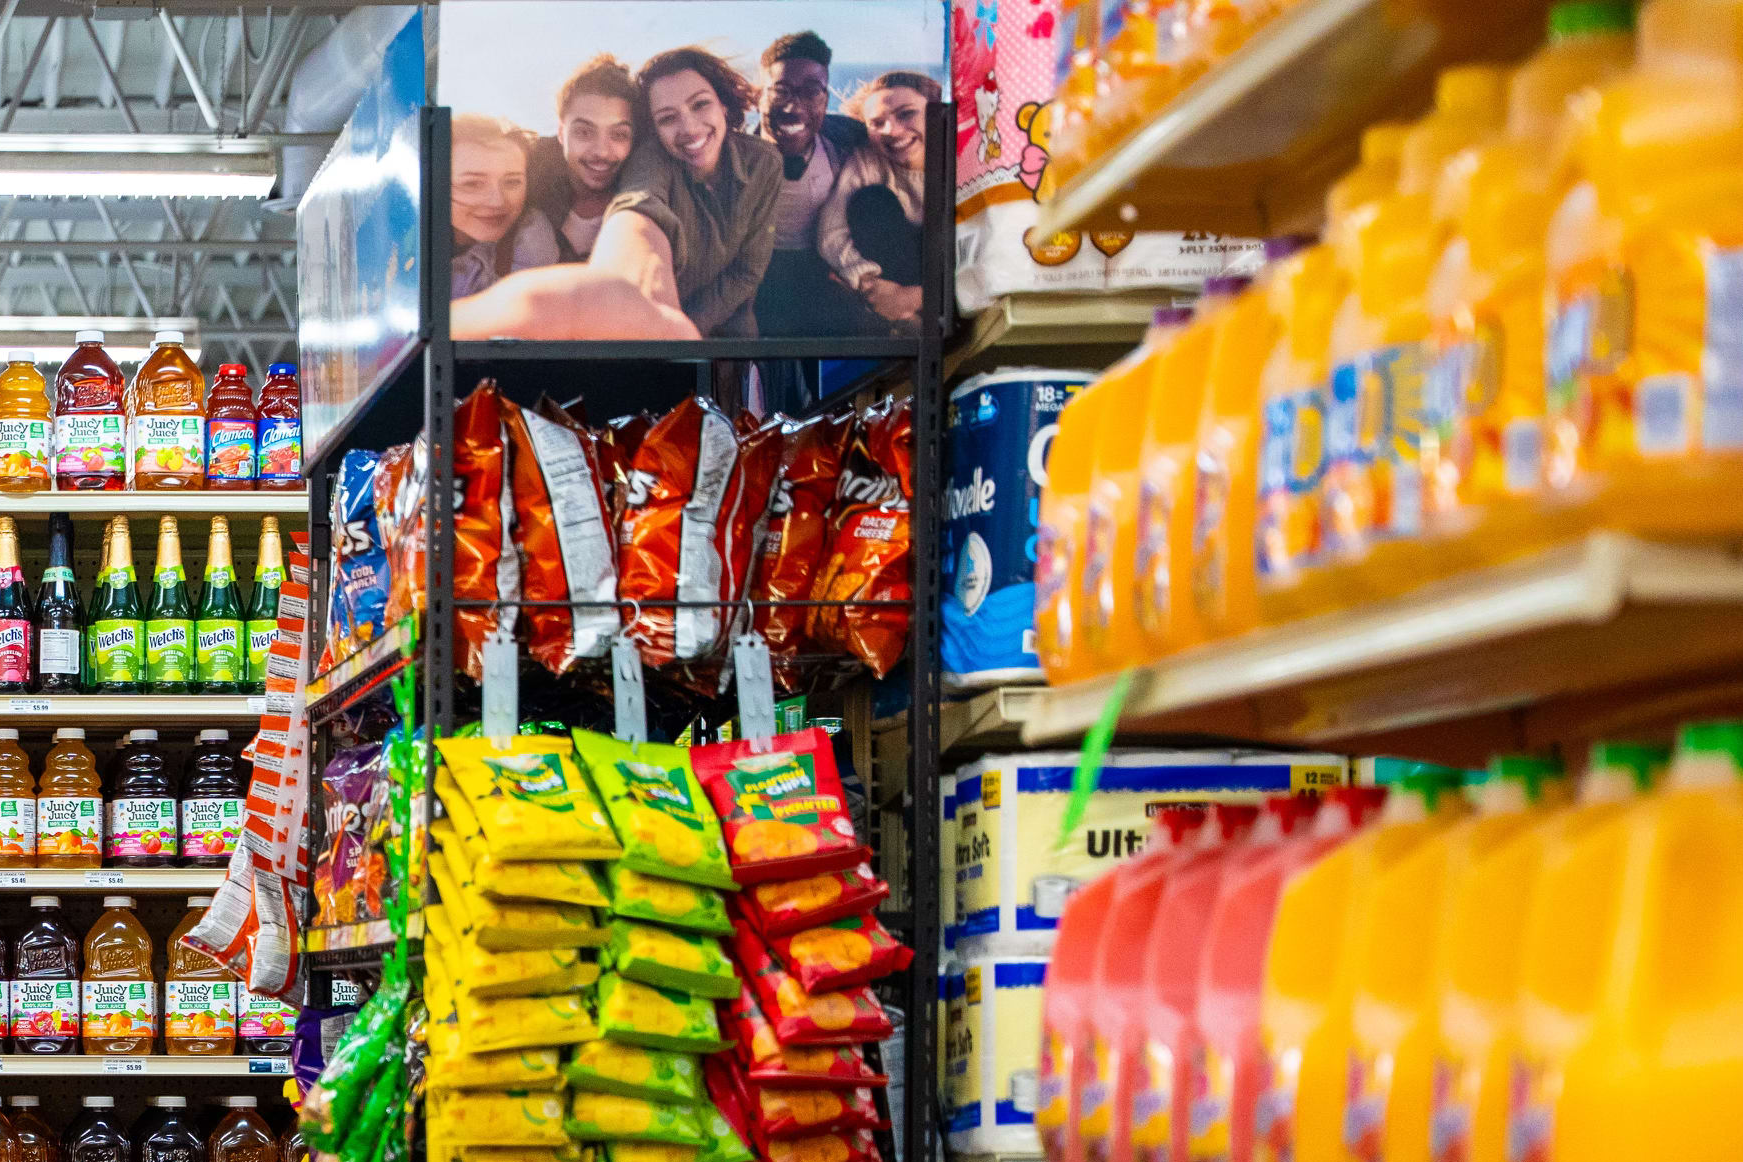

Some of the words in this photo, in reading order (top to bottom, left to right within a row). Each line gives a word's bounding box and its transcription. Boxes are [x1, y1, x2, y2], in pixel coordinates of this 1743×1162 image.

[212, 429, 254, 447] Clamato
[262, 425, 300, 447] Clamat
[861, 516, 898, 529] NACHO
[854, 526, 892, 540] CHEESE
[98, 627, 134, 648] Welch's
[148, 628, 185, 648] Welch's
[198, 627, 236, 648] Welch's
[46, 800, 79, 813] Juicy
[48, 811, 77, 820] Juice
[1087, 829, 1142, 858] Ult
[20, 982, 55, 995] Juicy
[23, 992, 52, 1002] Juice
